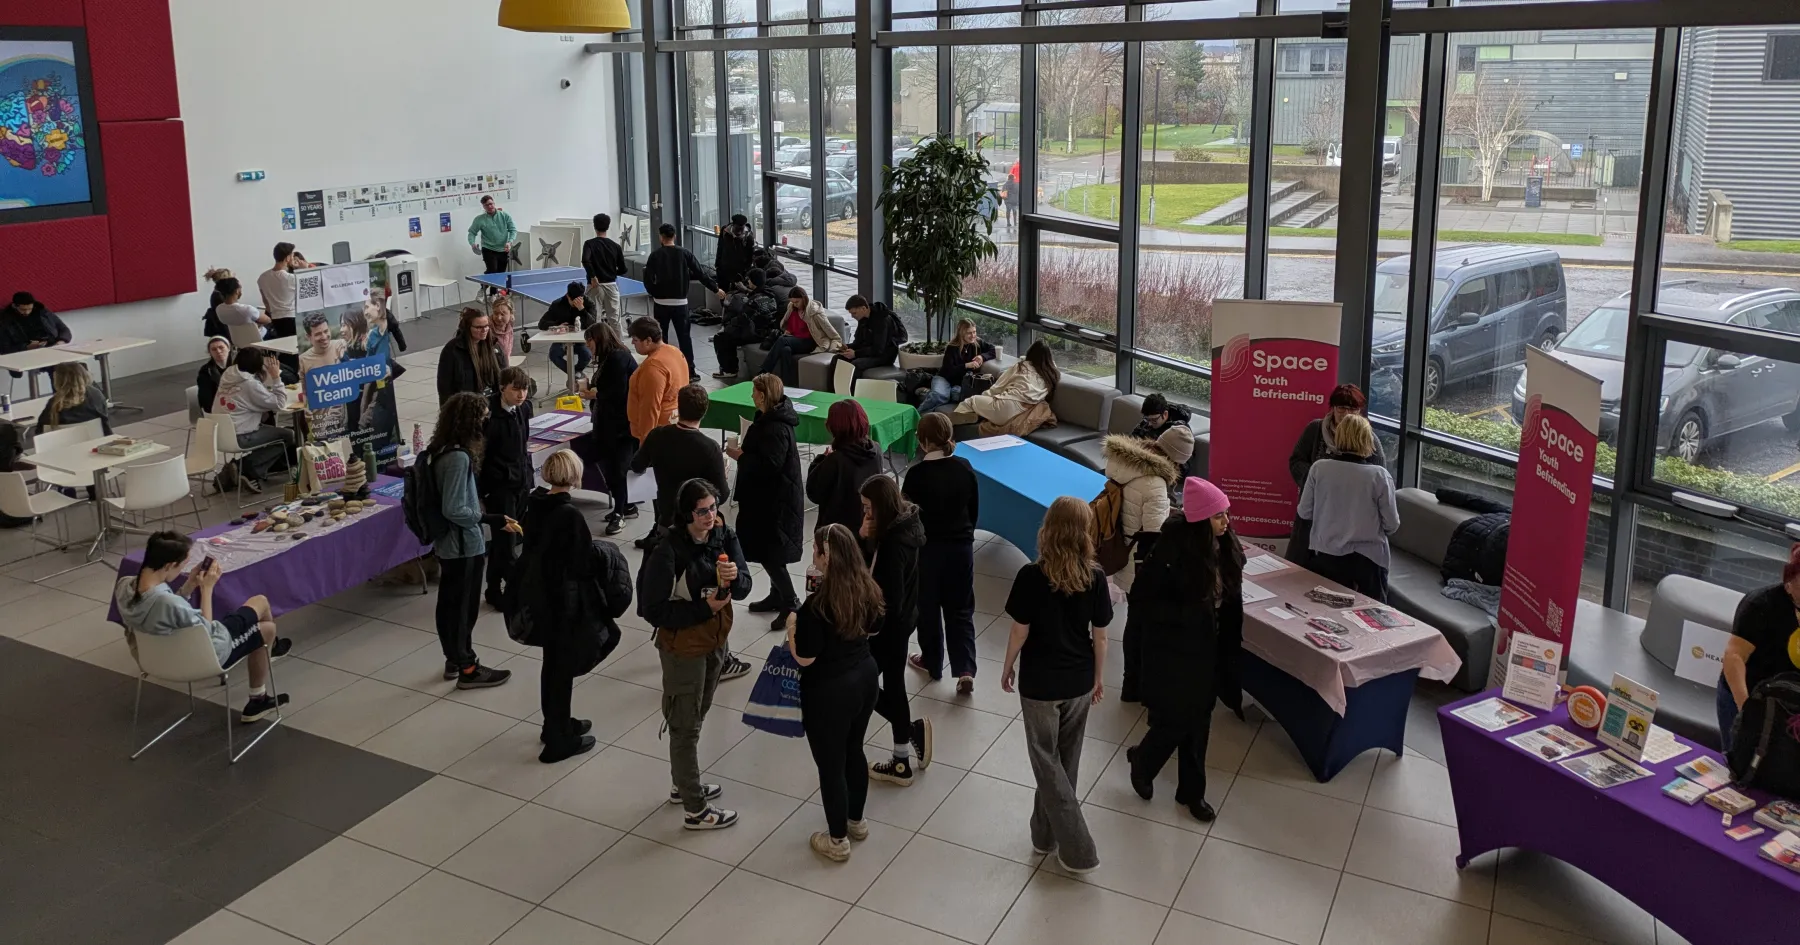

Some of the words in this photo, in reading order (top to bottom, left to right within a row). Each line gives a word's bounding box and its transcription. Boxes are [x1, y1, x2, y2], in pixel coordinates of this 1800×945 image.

[307, 203, 323, 211] YEARS
[1252, 349, 1328, 373] Space
[313, 364, 381, 387] Wellbeing
[1253, 374, 1288, 386] Youth
[314, 386, 353, 403] Team
[1252, 387, 1325, 404] Befriending
[311, 420, 340, 429] Activities
[312, 426, 345, 438] Workshops
[351, 427, 374, 437] Products
[356, 431, 388, 444] Coordinator
[1540, 417, 1584, 463] Space
[1538, 446, 1559, 471] Youth
[1535, 463, 1577, 505] Befriending
[1706, 653, 1724, 663] HEAL
